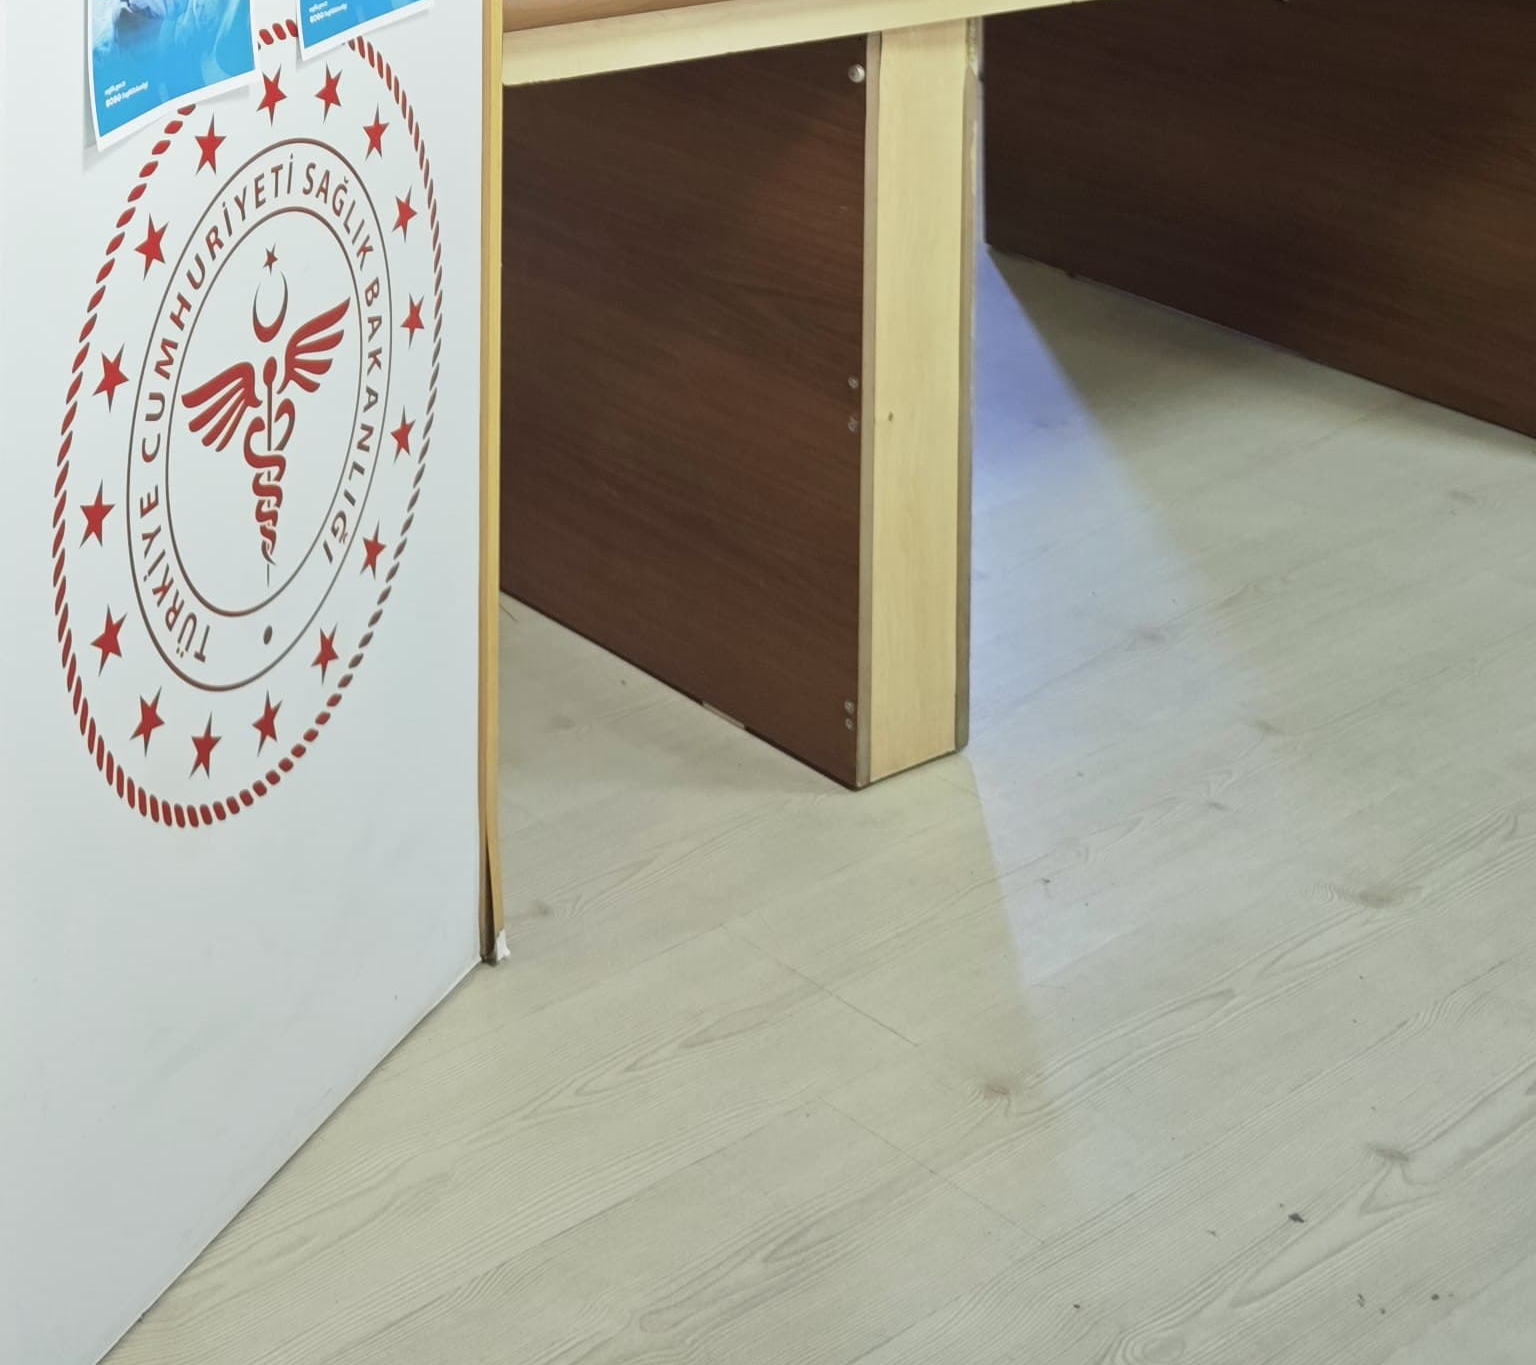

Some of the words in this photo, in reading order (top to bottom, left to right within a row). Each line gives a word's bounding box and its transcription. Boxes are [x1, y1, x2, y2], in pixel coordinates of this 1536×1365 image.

[141, 153, 294, 463] CUMHURİYETİ
[302, 162, 374, 271] SAĞLIK
[323, 277, 383, 564] BAKANLIĞI
[140, 485, 210, 662] TÜRKİYE
